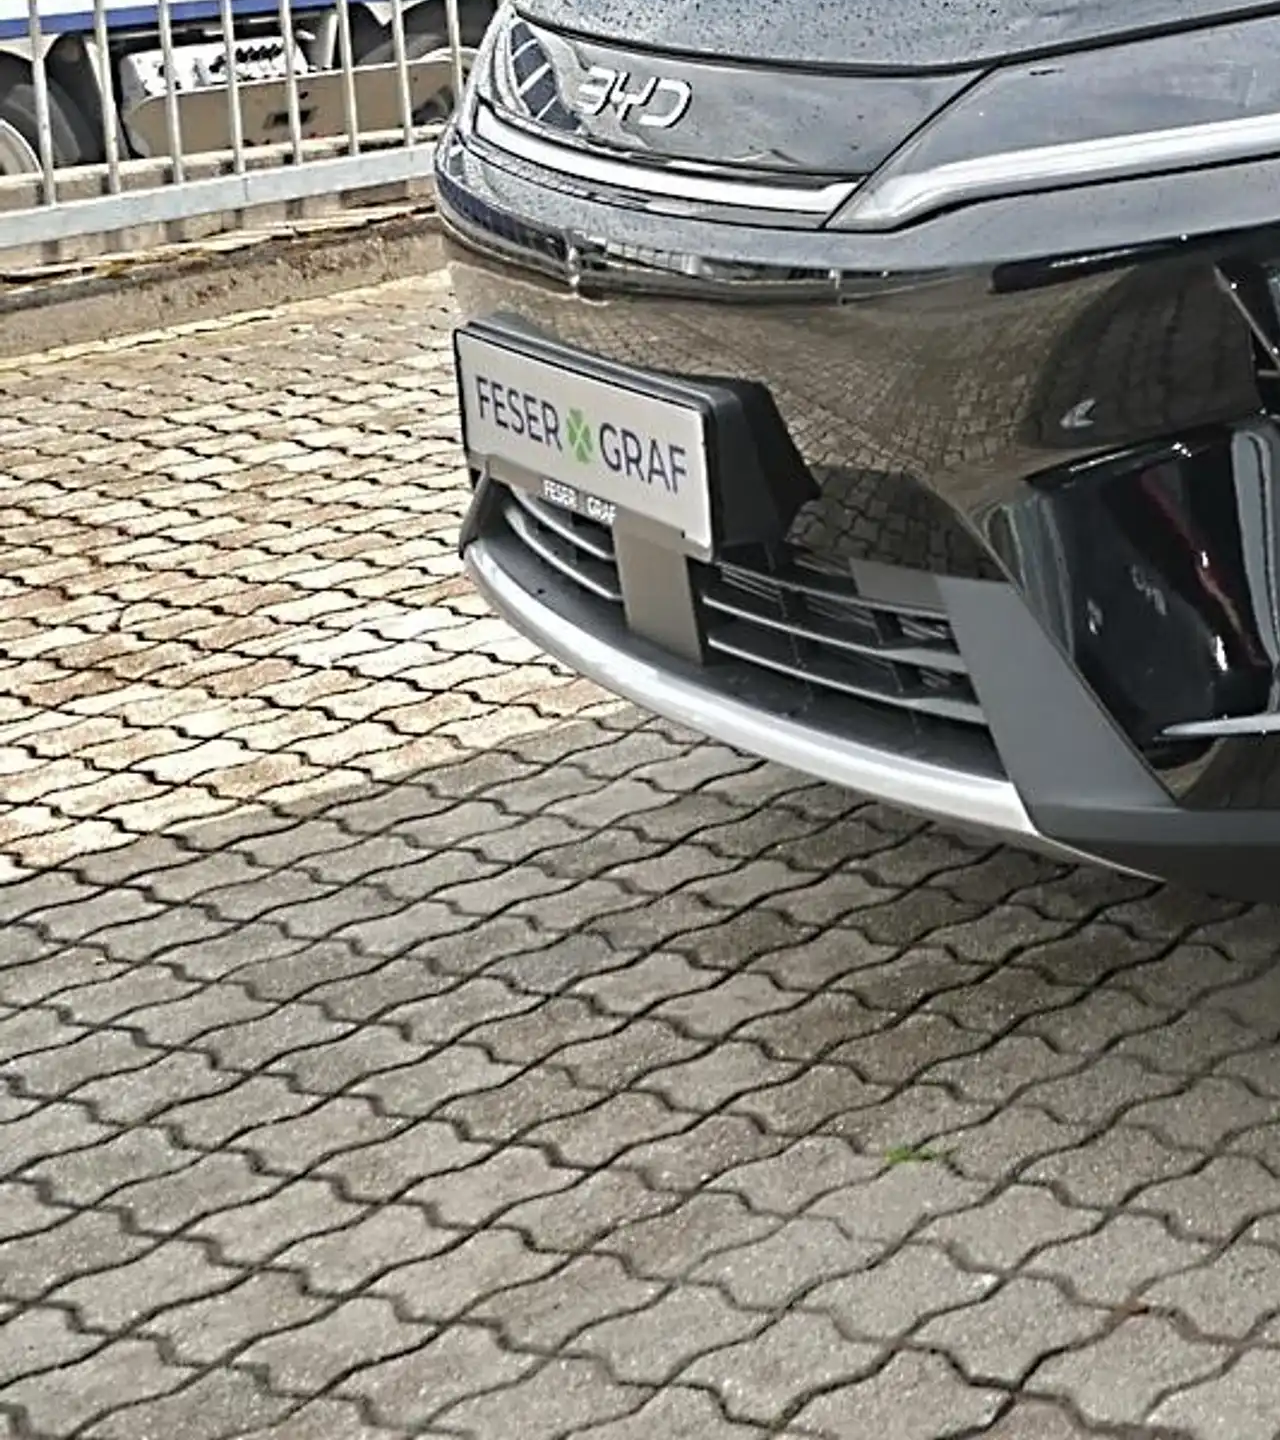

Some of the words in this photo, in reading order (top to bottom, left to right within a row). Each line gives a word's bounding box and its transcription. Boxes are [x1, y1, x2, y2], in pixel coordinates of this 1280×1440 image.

[578, 66, 693, 128] BYD
[475, 375, 563, 452] FESER
[599, 422, 687, 494] GRAF
